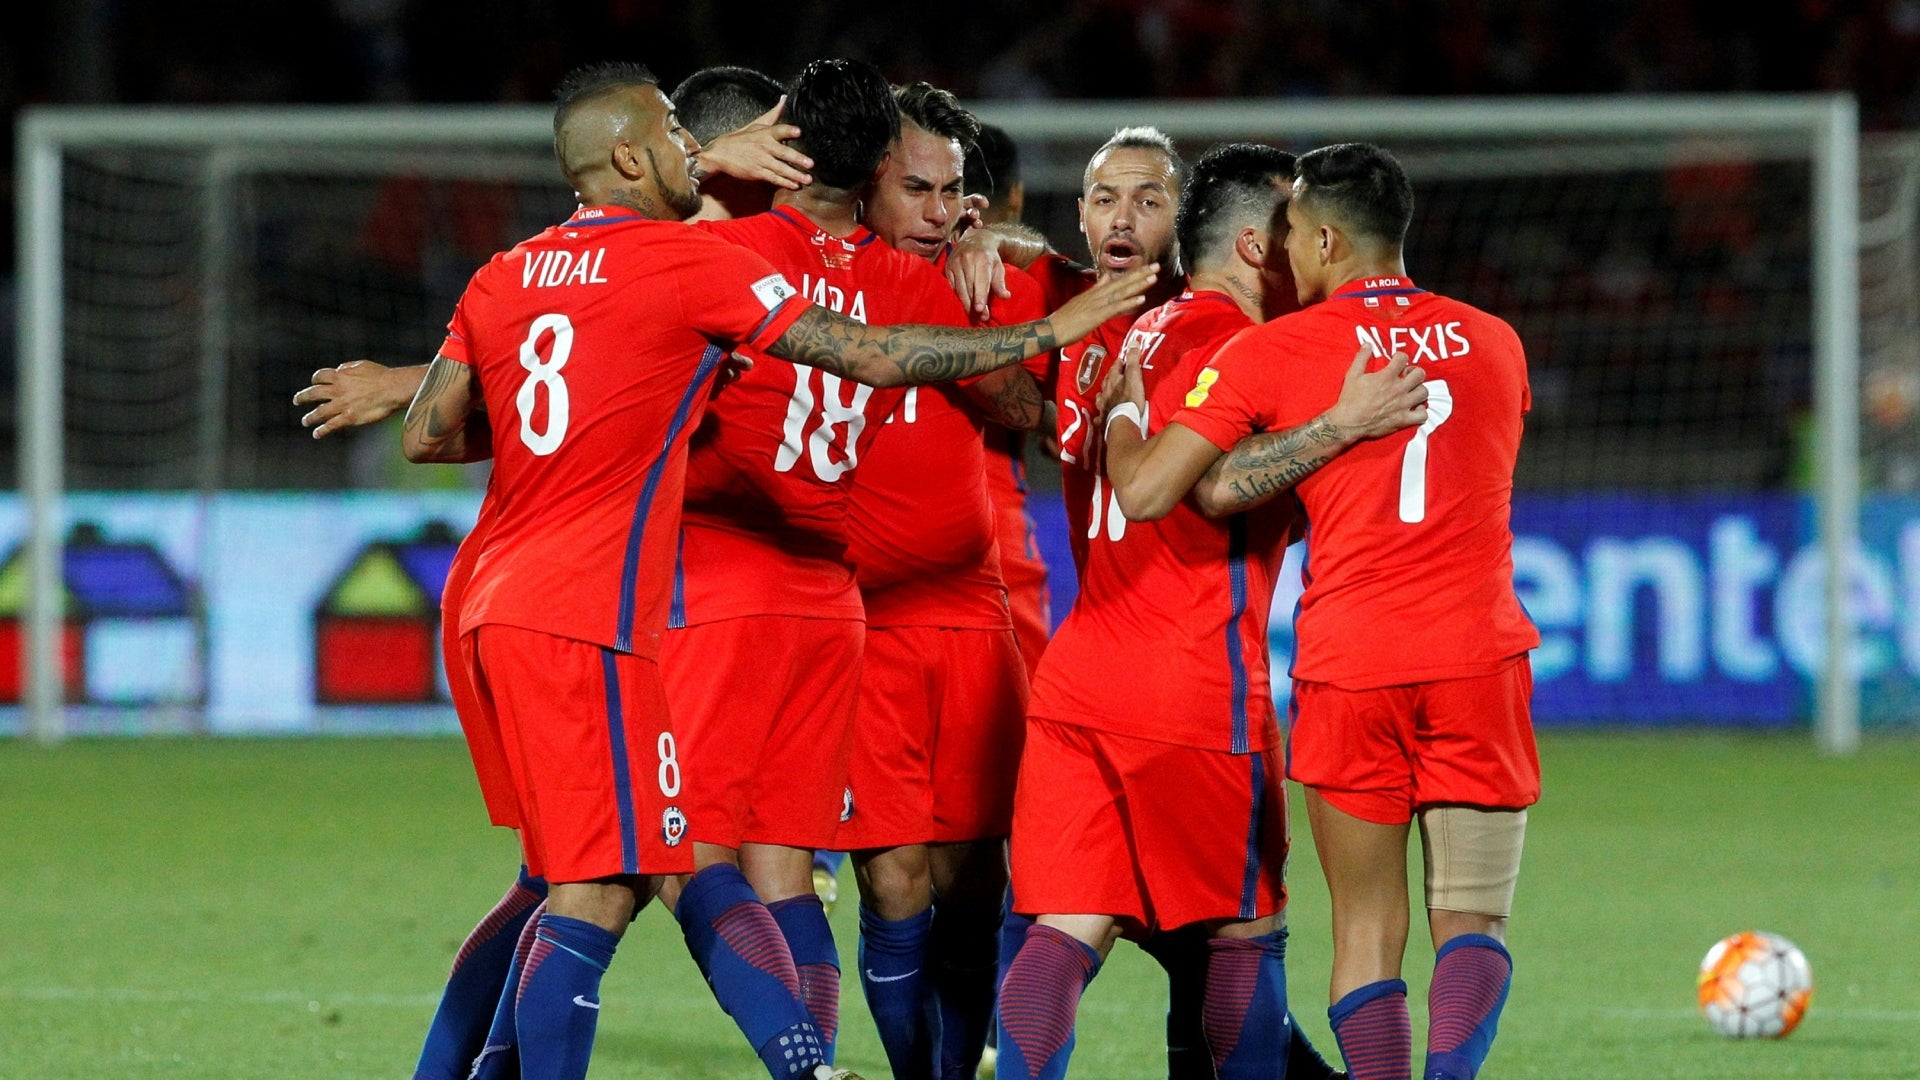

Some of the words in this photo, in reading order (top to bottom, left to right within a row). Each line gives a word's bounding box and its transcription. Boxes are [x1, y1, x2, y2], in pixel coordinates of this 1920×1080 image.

[578, 210, 586, 219] LA
[586, 209, 604, 219] ROJA
[522, 248, 607, 288] VIDAL
[1365, 280, 1378, 289] LA
[1379, 278, 1400, 287] ROJA
[1355, 321, 1470, 364] ALEXIS
[516, 313, 574, 456] 8
[774, 363, 874, 482] 18
[1398, 379, 1453, 523] 7
[658, 731, 681, 797] 8
